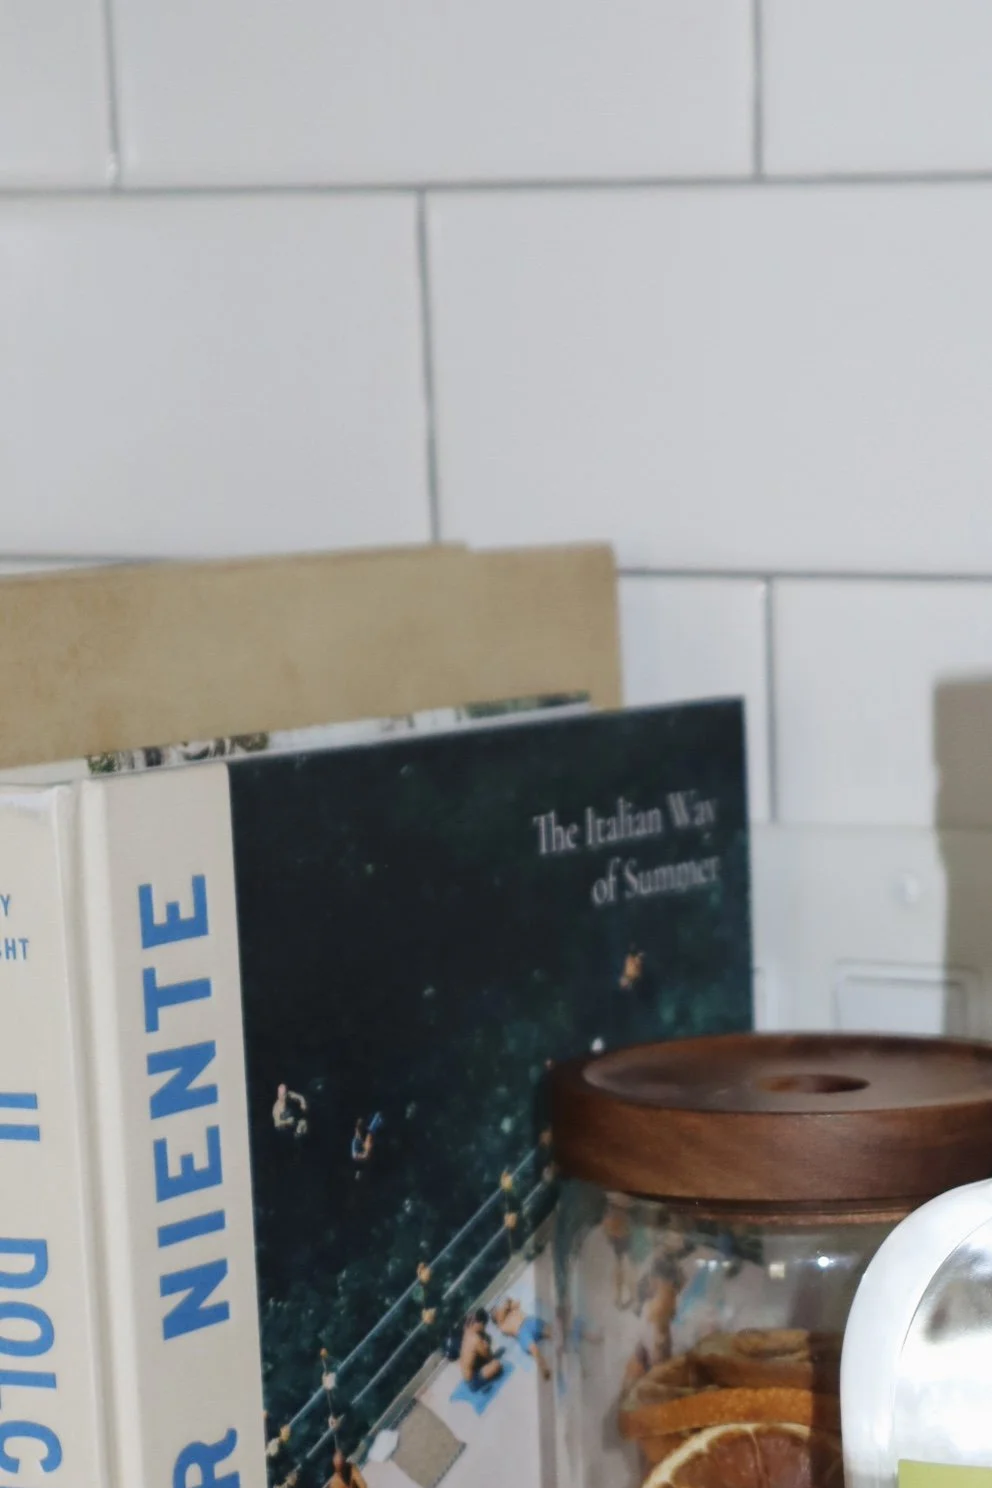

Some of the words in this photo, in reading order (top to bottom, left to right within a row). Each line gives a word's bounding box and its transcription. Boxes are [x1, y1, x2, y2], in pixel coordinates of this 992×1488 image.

[533, 809, 579, 855] The
[585, 796, 663, 846] Italian
[666, 789, 717, 843] Way
[591, 857, 622, 905] of
[623, 857, 721, 899] Summer
[138, 873, 230, 1341] NIENTE
